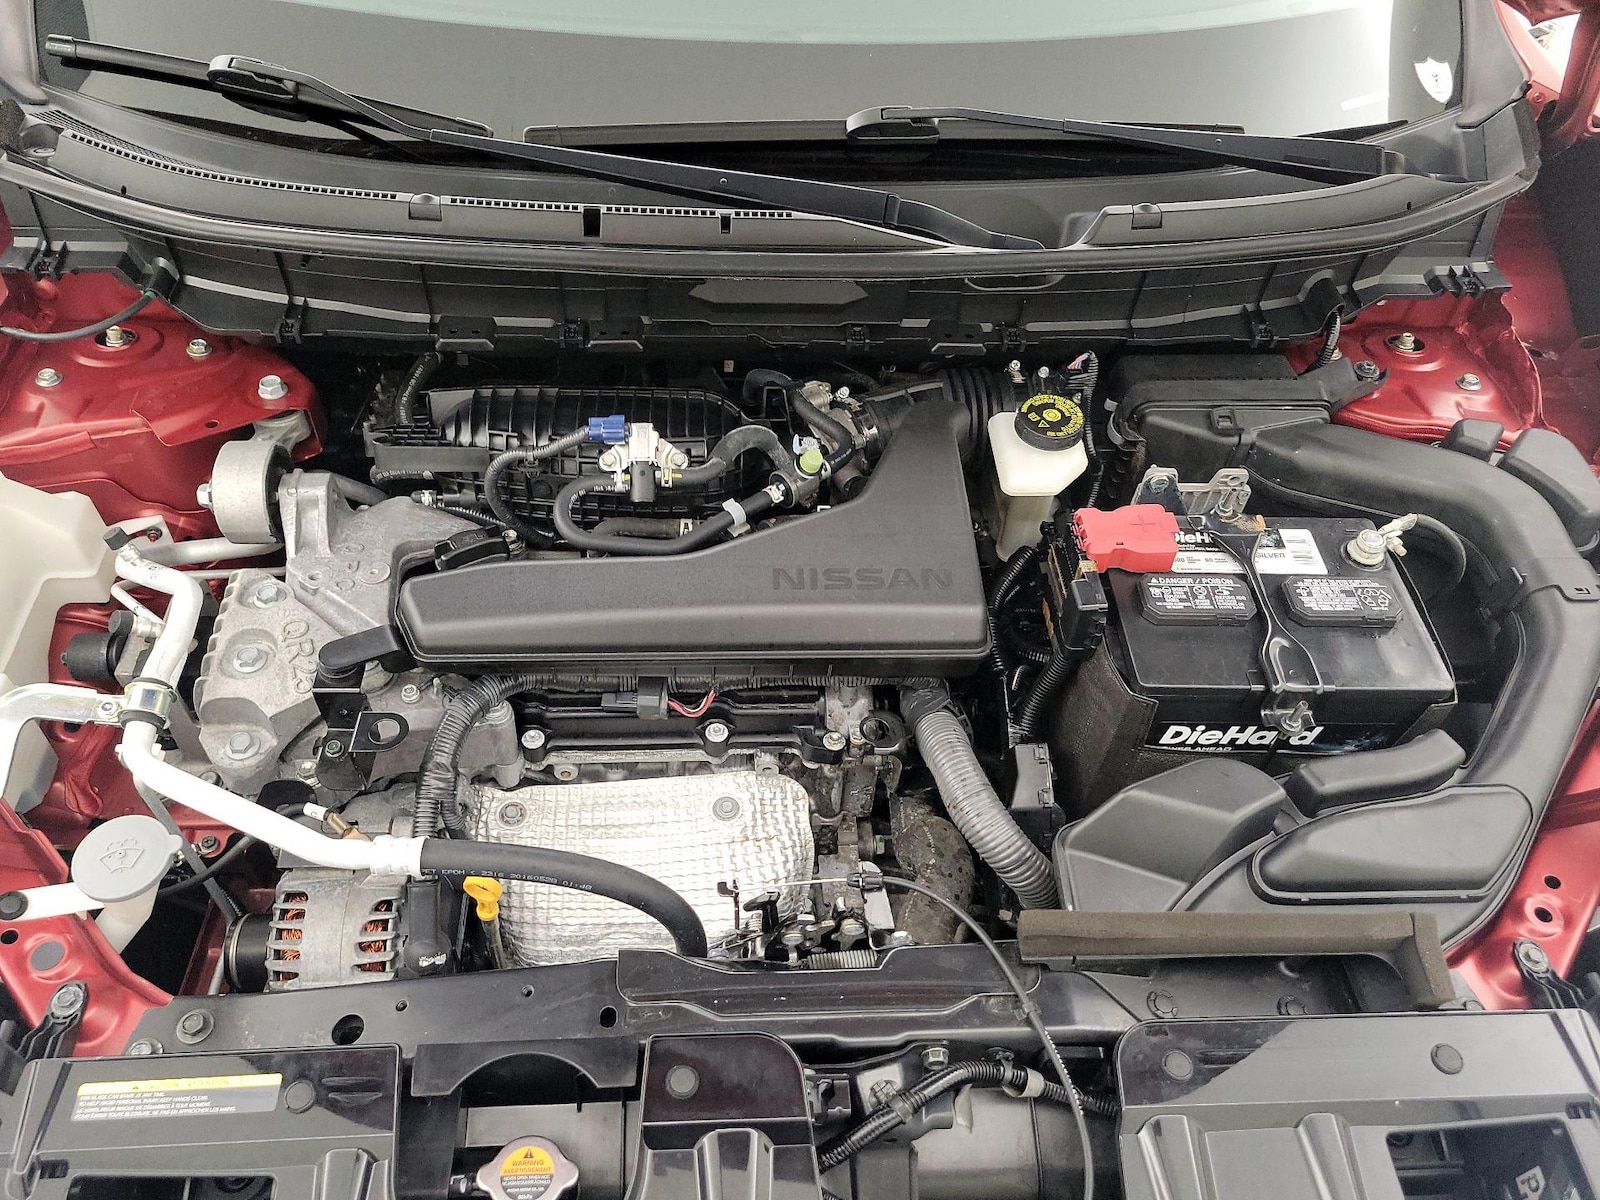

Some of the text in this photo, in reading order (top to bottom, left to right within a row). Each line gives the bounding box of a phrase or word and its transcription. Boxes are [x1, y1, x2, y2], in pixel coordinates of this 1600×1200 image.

[772, 567, 953, 591] NISSAN
[1201, 577, 1234, 585] POISON
[1158, 725, 1325, 746] DieHad
[512, 1159, 545, 1167] WARNING
[503, 1166, 552, 1174] AVERTISSEMENT
